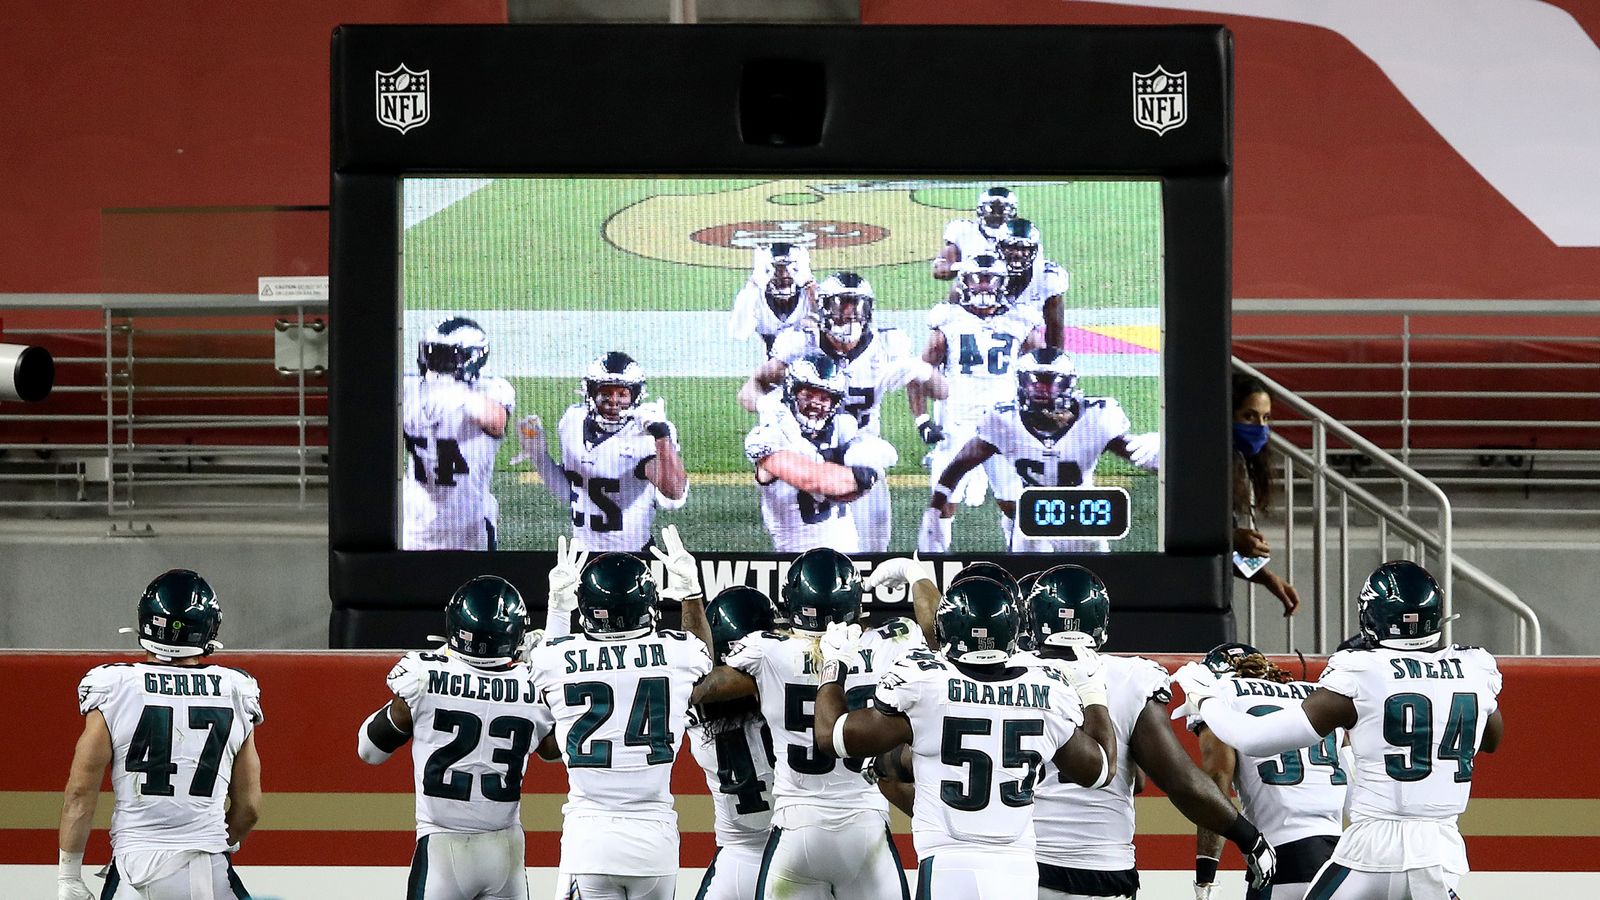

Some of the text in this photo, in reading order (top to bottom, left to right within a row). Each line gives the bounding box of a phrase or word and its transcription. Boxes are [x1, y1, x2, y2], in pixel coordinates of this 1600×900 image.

[382, 95, 423, 123] NFL
[1140, 96, 1181, 125] NFL
[1035, 499, 1111, 526] 00:09
[1064, 618, 1081, 631] 91
[565, 643, 667, 674] SLAY JR
[1390, 658, 1465, 680] SWEAT
[144, 672, 222, 697] GERRY
[948, 678, 1052, 710] GRAHAM
[1231, 679, 1320, 700] LEBLAN
[564, 676, 675, 768] 24
[125, 704, 234, 798] 47
[1383, 692, 1479, 783] 94
[423, 708, 535, 802] 23
[940, 715, 1045, 812] 55
